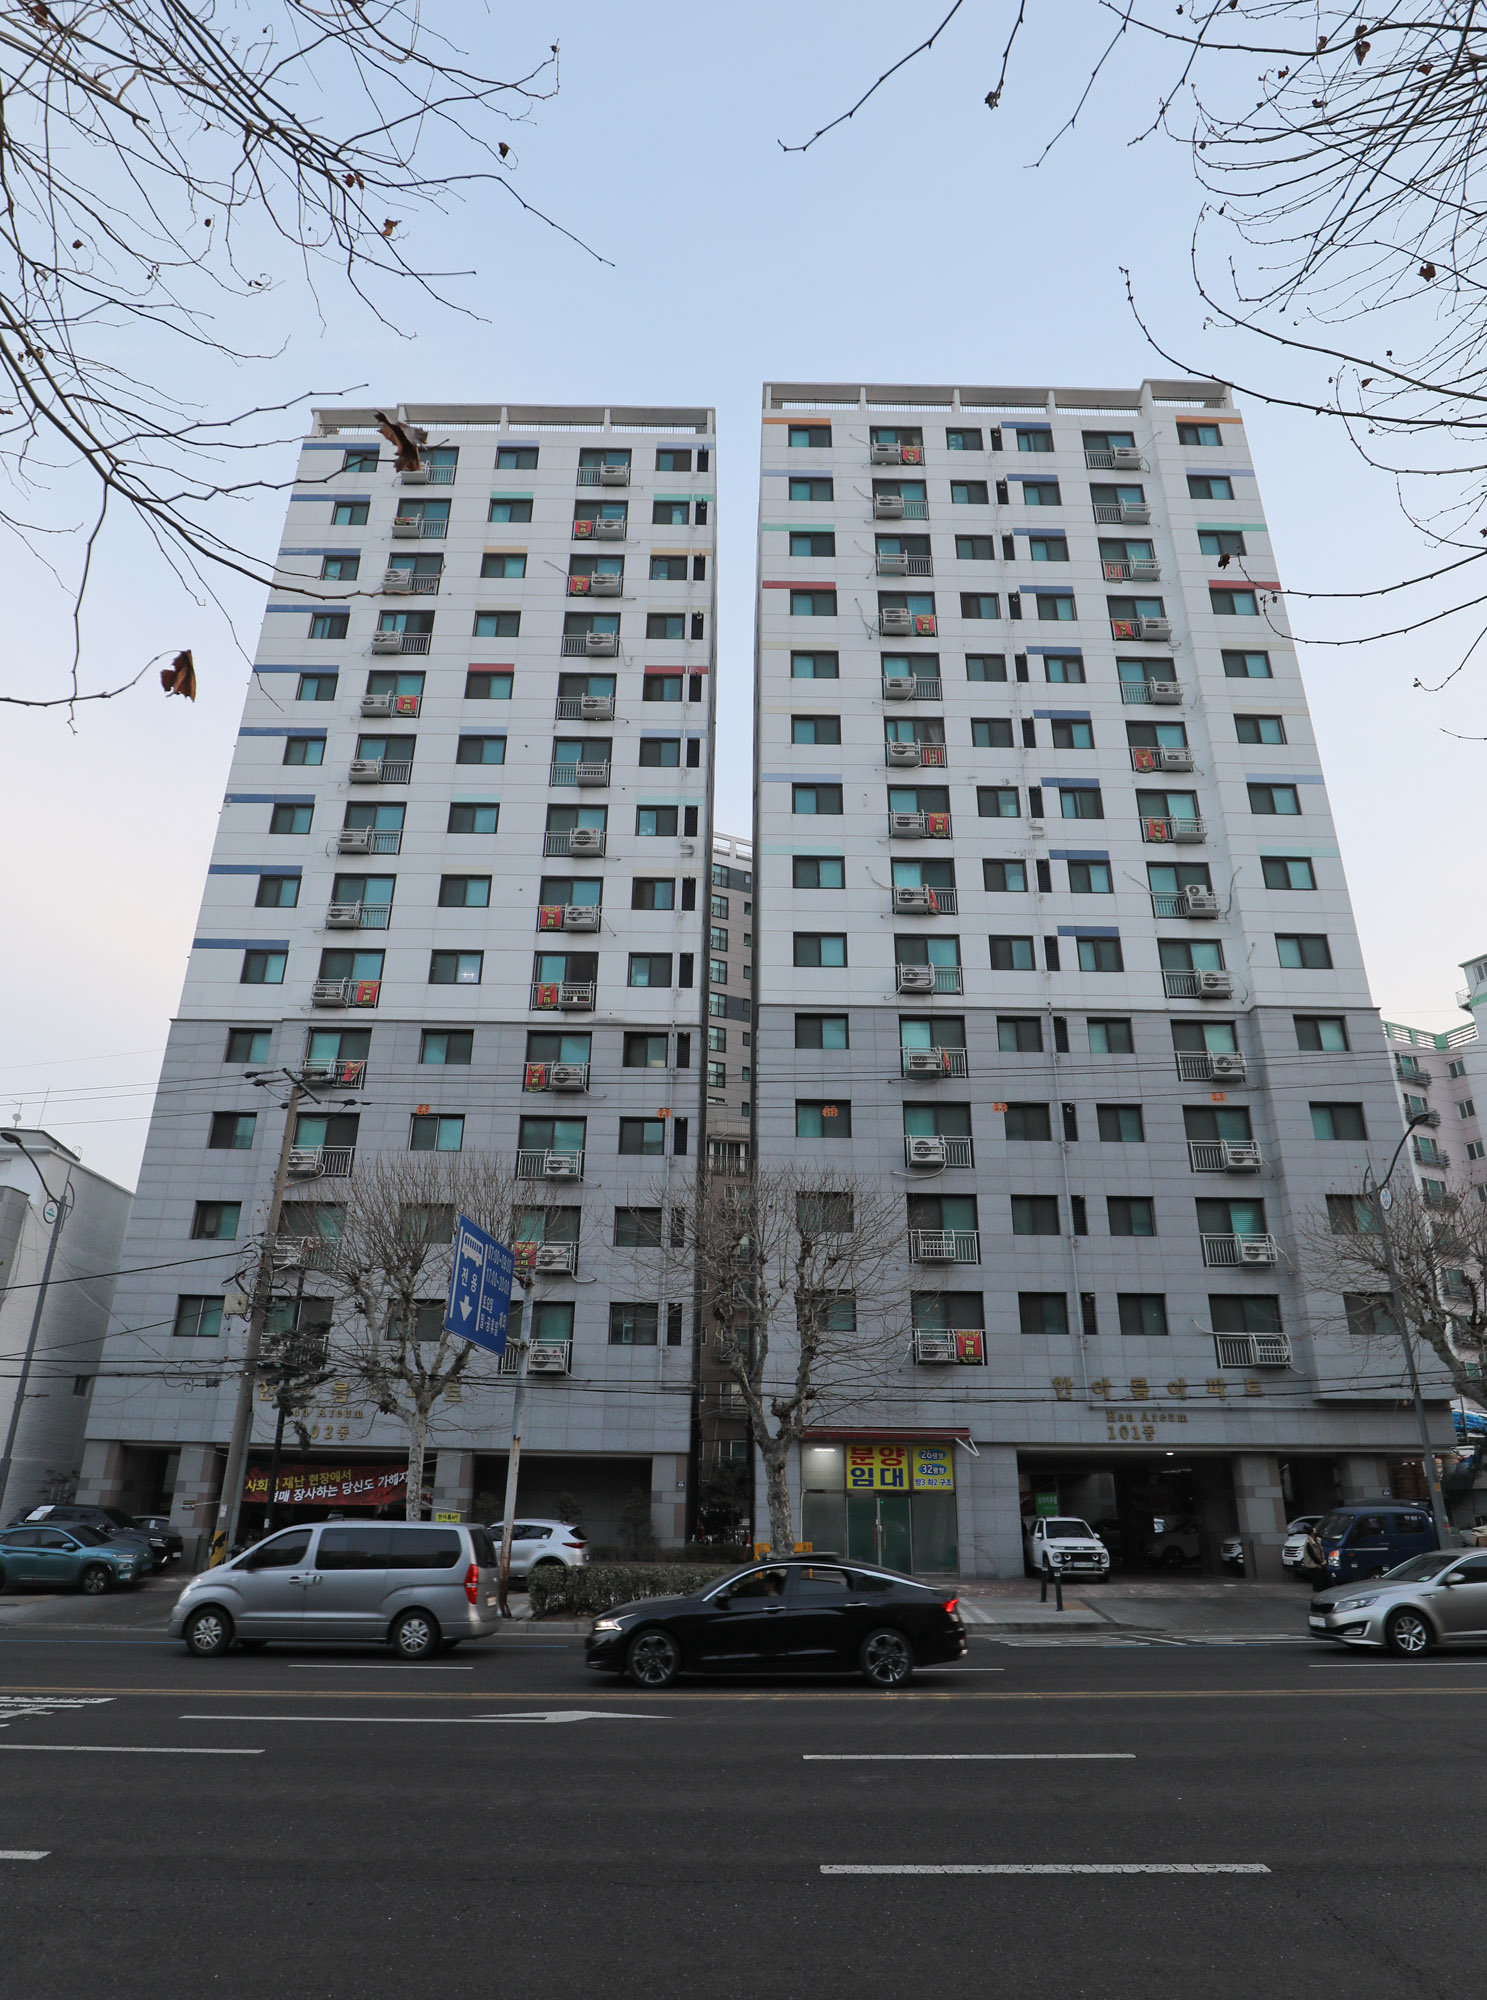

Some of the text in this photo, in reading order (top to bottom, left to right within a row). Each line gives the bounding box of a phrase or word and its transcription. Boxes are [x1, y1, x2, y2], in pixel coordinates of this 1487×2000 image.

[461, 1267, 477, 1293] 전용
[1051, 1376, 1264, 1402] 한아름아파트
[1106, 1411, 1188, 1423] Han Areum
[303, 1423, 349, 1440] 02동
[1107, 1425, 1156, 1441] 101동
[850, 1446, 906, 1467] 분양
[282, 1475, 305, 1490] 재난
[308, 1469, 352, 1486] 현장에서
[850, 1467, 904, 1488] 임대
[293, 1485, 339, 1502] 장사하는
[342, 1478, 374, 1495] 당신도
